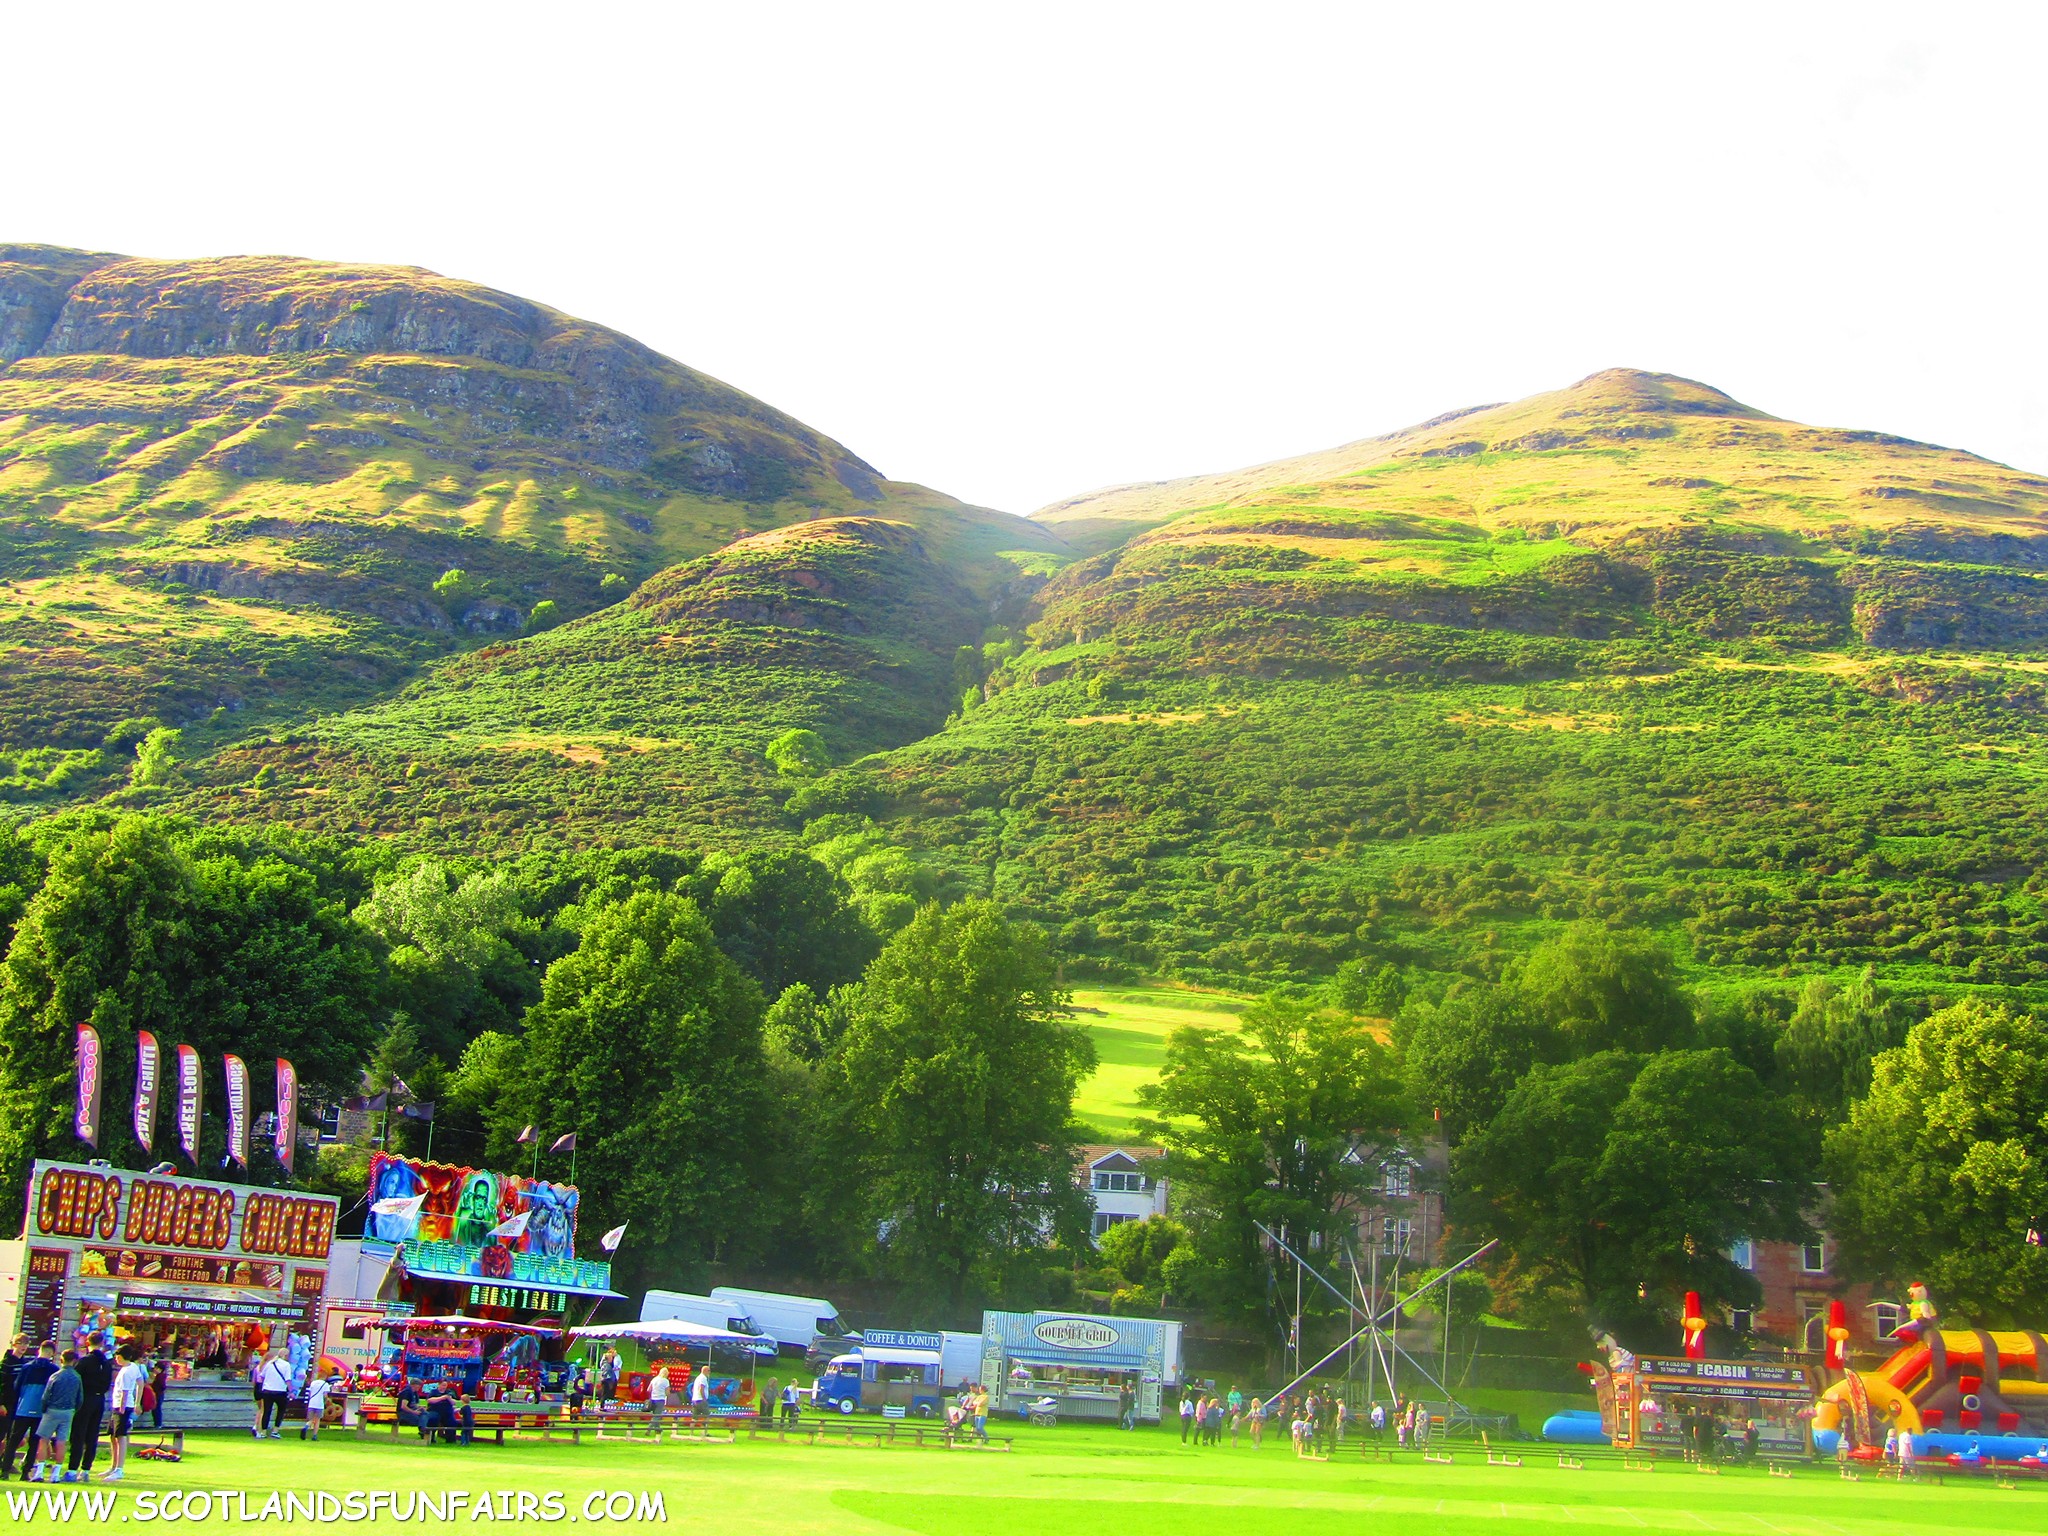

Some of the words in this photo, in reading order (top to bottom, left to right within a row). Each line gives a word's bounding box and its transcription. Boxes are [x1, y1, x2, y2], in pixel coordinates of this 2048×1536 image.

[38, 1168, 122, 1240] CHIPS
[124, 1178, 235, 1250] BURGERS
[240, 1192, 337, 1258] CHICKEN
[104, 1250, 118, 1258] CHIPS
[32, 1256, 65, 1272] MENU
[172, 1256, 205, 1269] FUNTIME
[163, 1268, 190, 1280] STREET
[192, 1270, 210, 1282] FOOD
[296, 1276, 322, 1290] MENU
[122, 1296, 134, 1305] COLD
[134, 1297, 151, 1306] DRINKS
[154, 1299, 170, 1307] COFFEE
[174, 1300, 182, 1308] TEA
[214, 1303, 226, 1311] LATTE
[230, 1304, 238, 1312] HOT
[238, 1305, 261, 1314] CHOCOLATE
[866, 1332, 895, 1344] COFFEE
[898, 1337, 905, 1345] &
[908, 1336, 940, 1347] DONUTS
[1086, 1330, 1112, 1342] GRILL
[326, 1346, 350, 1355] GHOST
[354, 1348, 377, 1357] TRAIN
[1704, 1363, 1746, 1378] CABIN
